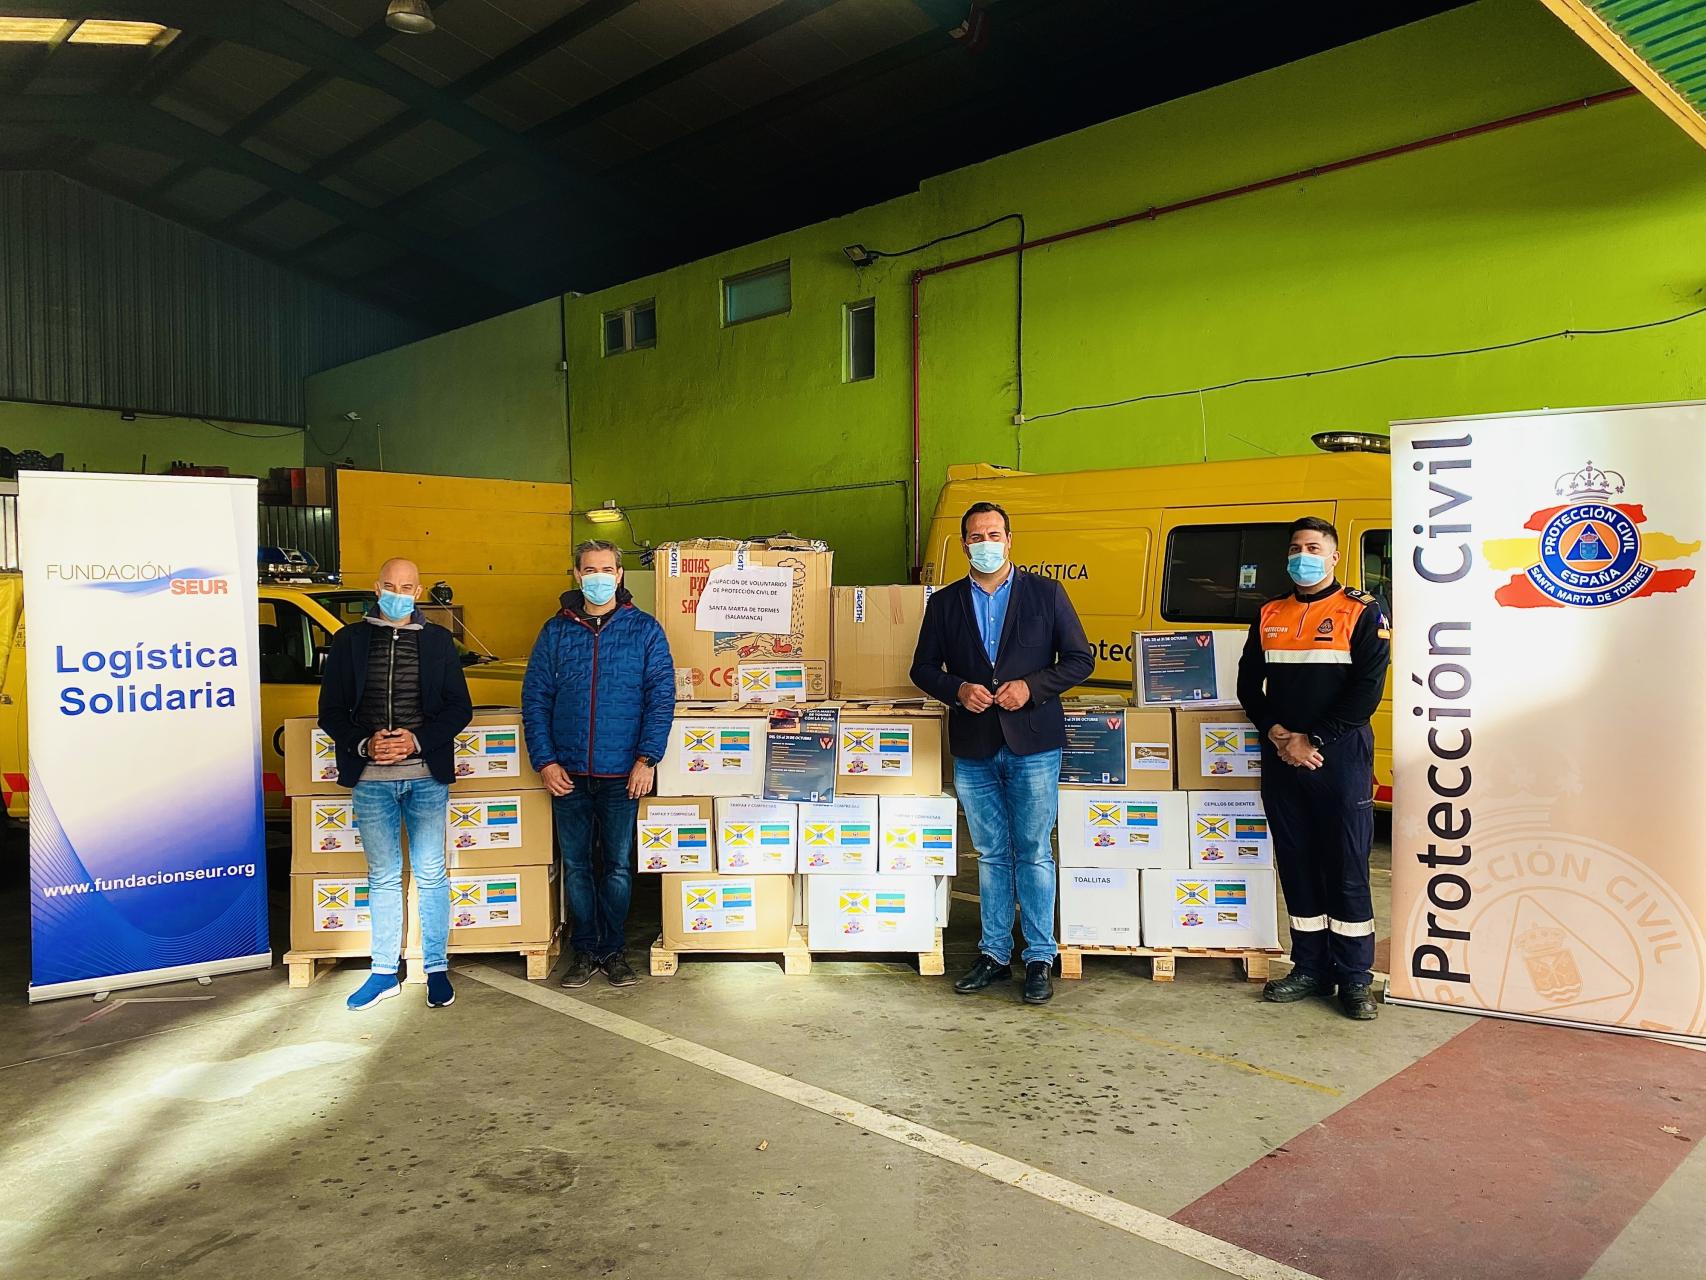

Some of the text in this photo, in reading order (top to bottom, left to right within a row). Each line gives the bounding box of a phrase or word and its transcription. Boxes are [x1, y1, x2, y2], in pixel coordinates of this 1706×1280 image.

[1411, 433, 1473, 583] Civil
[1545, 507, 1635, 556] PROTECCIÓN CIVIL
[46, 561, 171, 580] FUNDACIÓN
[681, 559, 710, 573] BOTAS
[1018, 560, 1089, 580] OGÍSTICA
[1561, 568, 1621, 586] ESPAÑA
[170, 579, 228, 595] SEUR
[1530, 565, 1649, 604] SANTA MARTA DE TORMES
[56, 641, 238, 679] Logística
[1088, 639, 1132, 662] otec
[60, 681, 236, 716] Solidaria
[1411, 621, 1473, 984] Protección
[43, 863, 256, 898] www.fundacionseur.org
[1605, 874, 1683, 964] CIVIL
